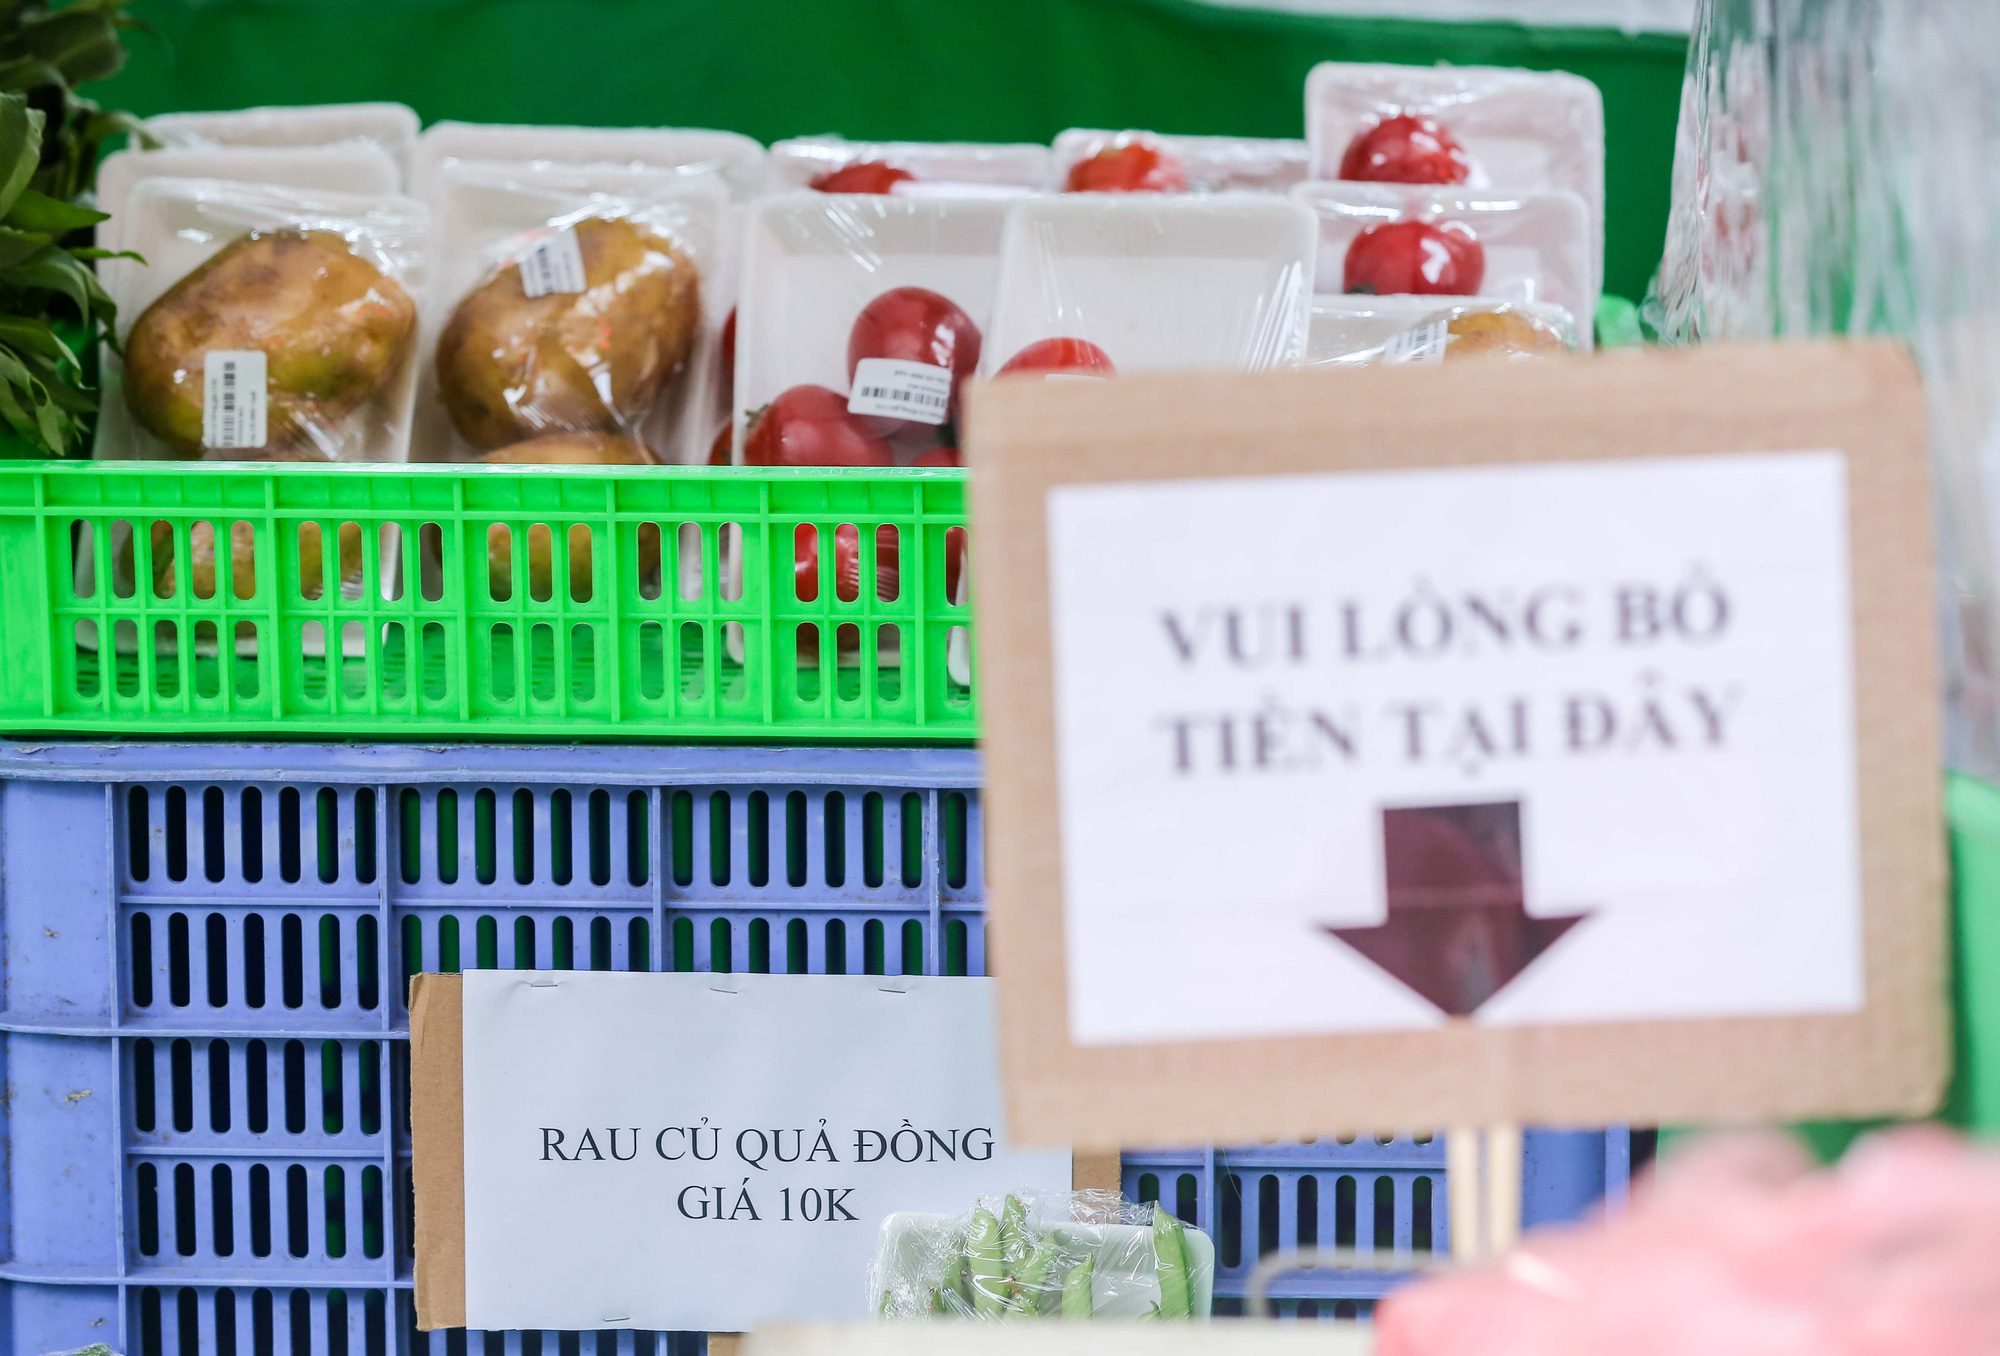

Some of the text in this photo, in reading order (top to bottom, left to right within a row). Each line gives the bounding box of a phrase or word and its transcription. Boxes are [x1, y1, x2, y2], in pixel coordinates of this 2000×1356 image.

[1156, 599, 1311, 671] VUI
[1337, 574, 1586, 664] LÒNG
[1388, 696, 1532, 777] TẠI
[1562, 670, 1742, 753] ĐÂY
[539, 1117, 996, 1171] RAU CỦ QUẢ ĐỒNG
[677, 1177, 860, 1222] GIÁ 10K
